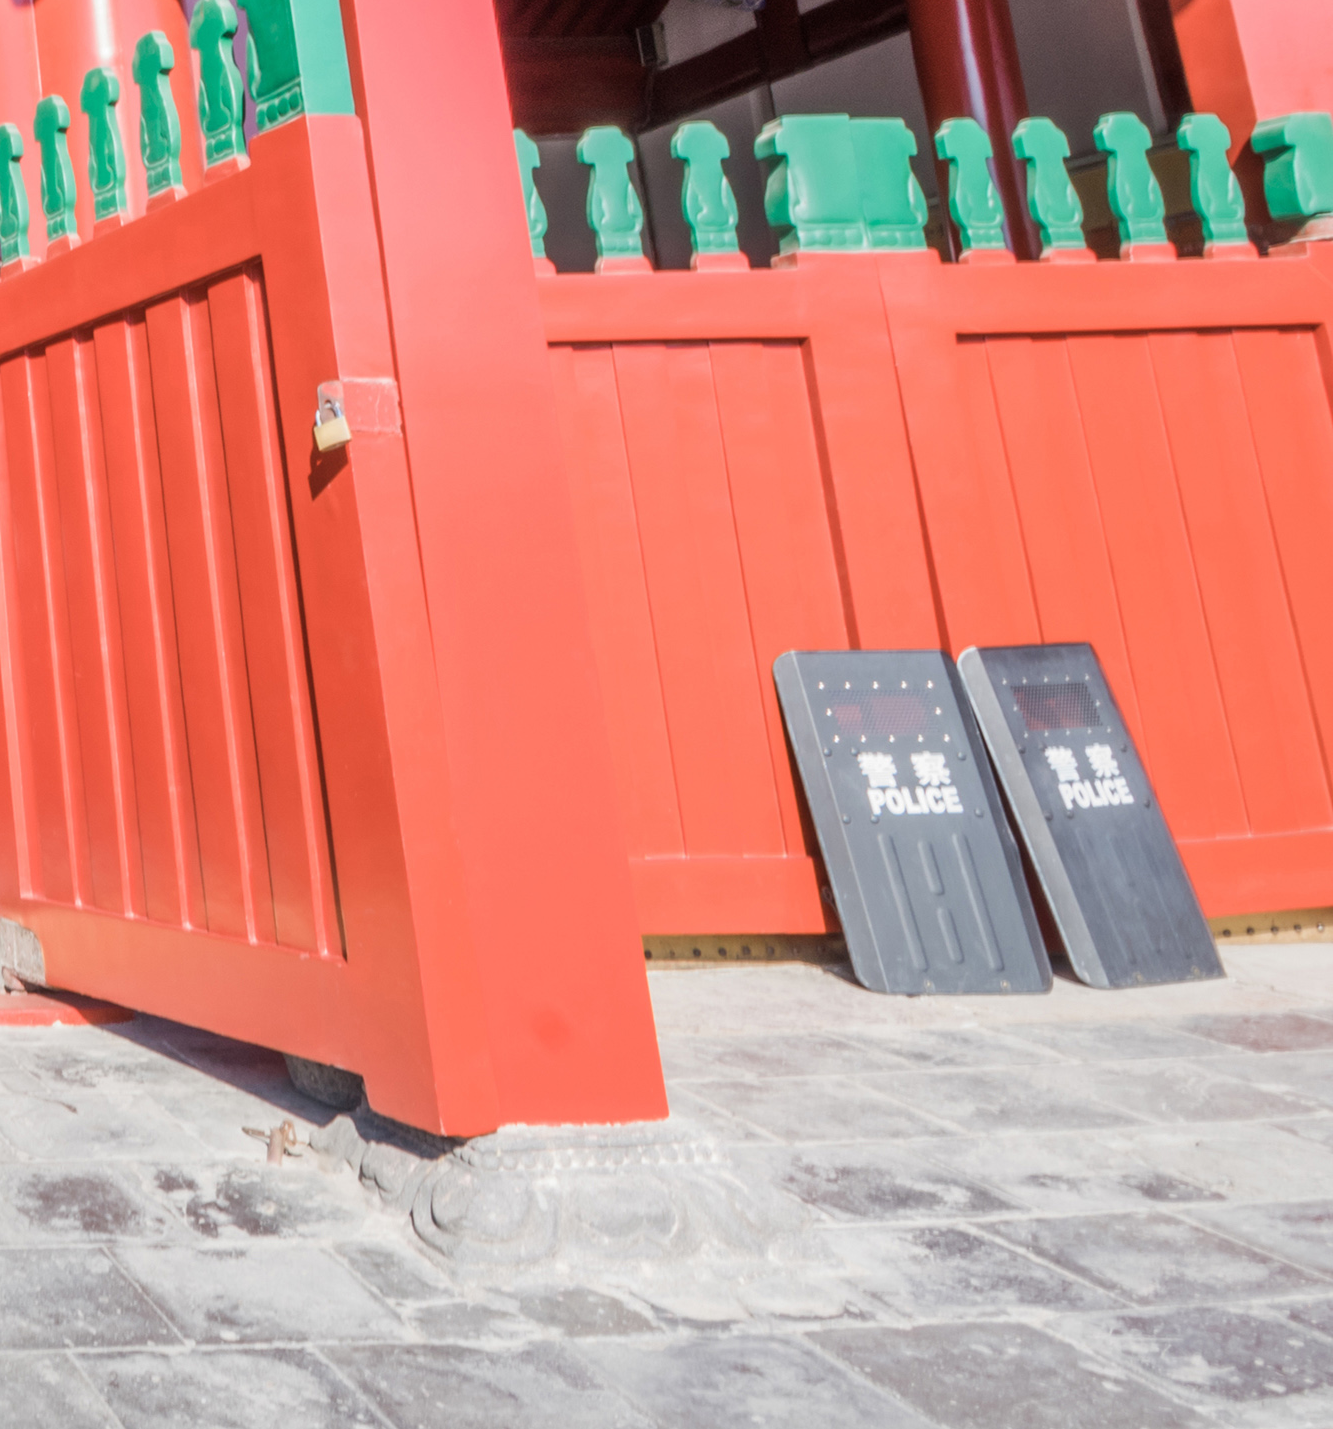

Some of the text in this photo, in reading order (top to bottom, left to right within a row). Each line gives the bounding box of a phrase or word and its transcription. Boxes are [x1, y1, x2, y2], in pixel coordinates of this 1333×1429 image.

[857, 751, 951, 788] 警察
[1044, 743, 1120, 782] 警察
[867, 786, 964, 815] POLICE
[1058, 776, 1134, 810] POLICE
